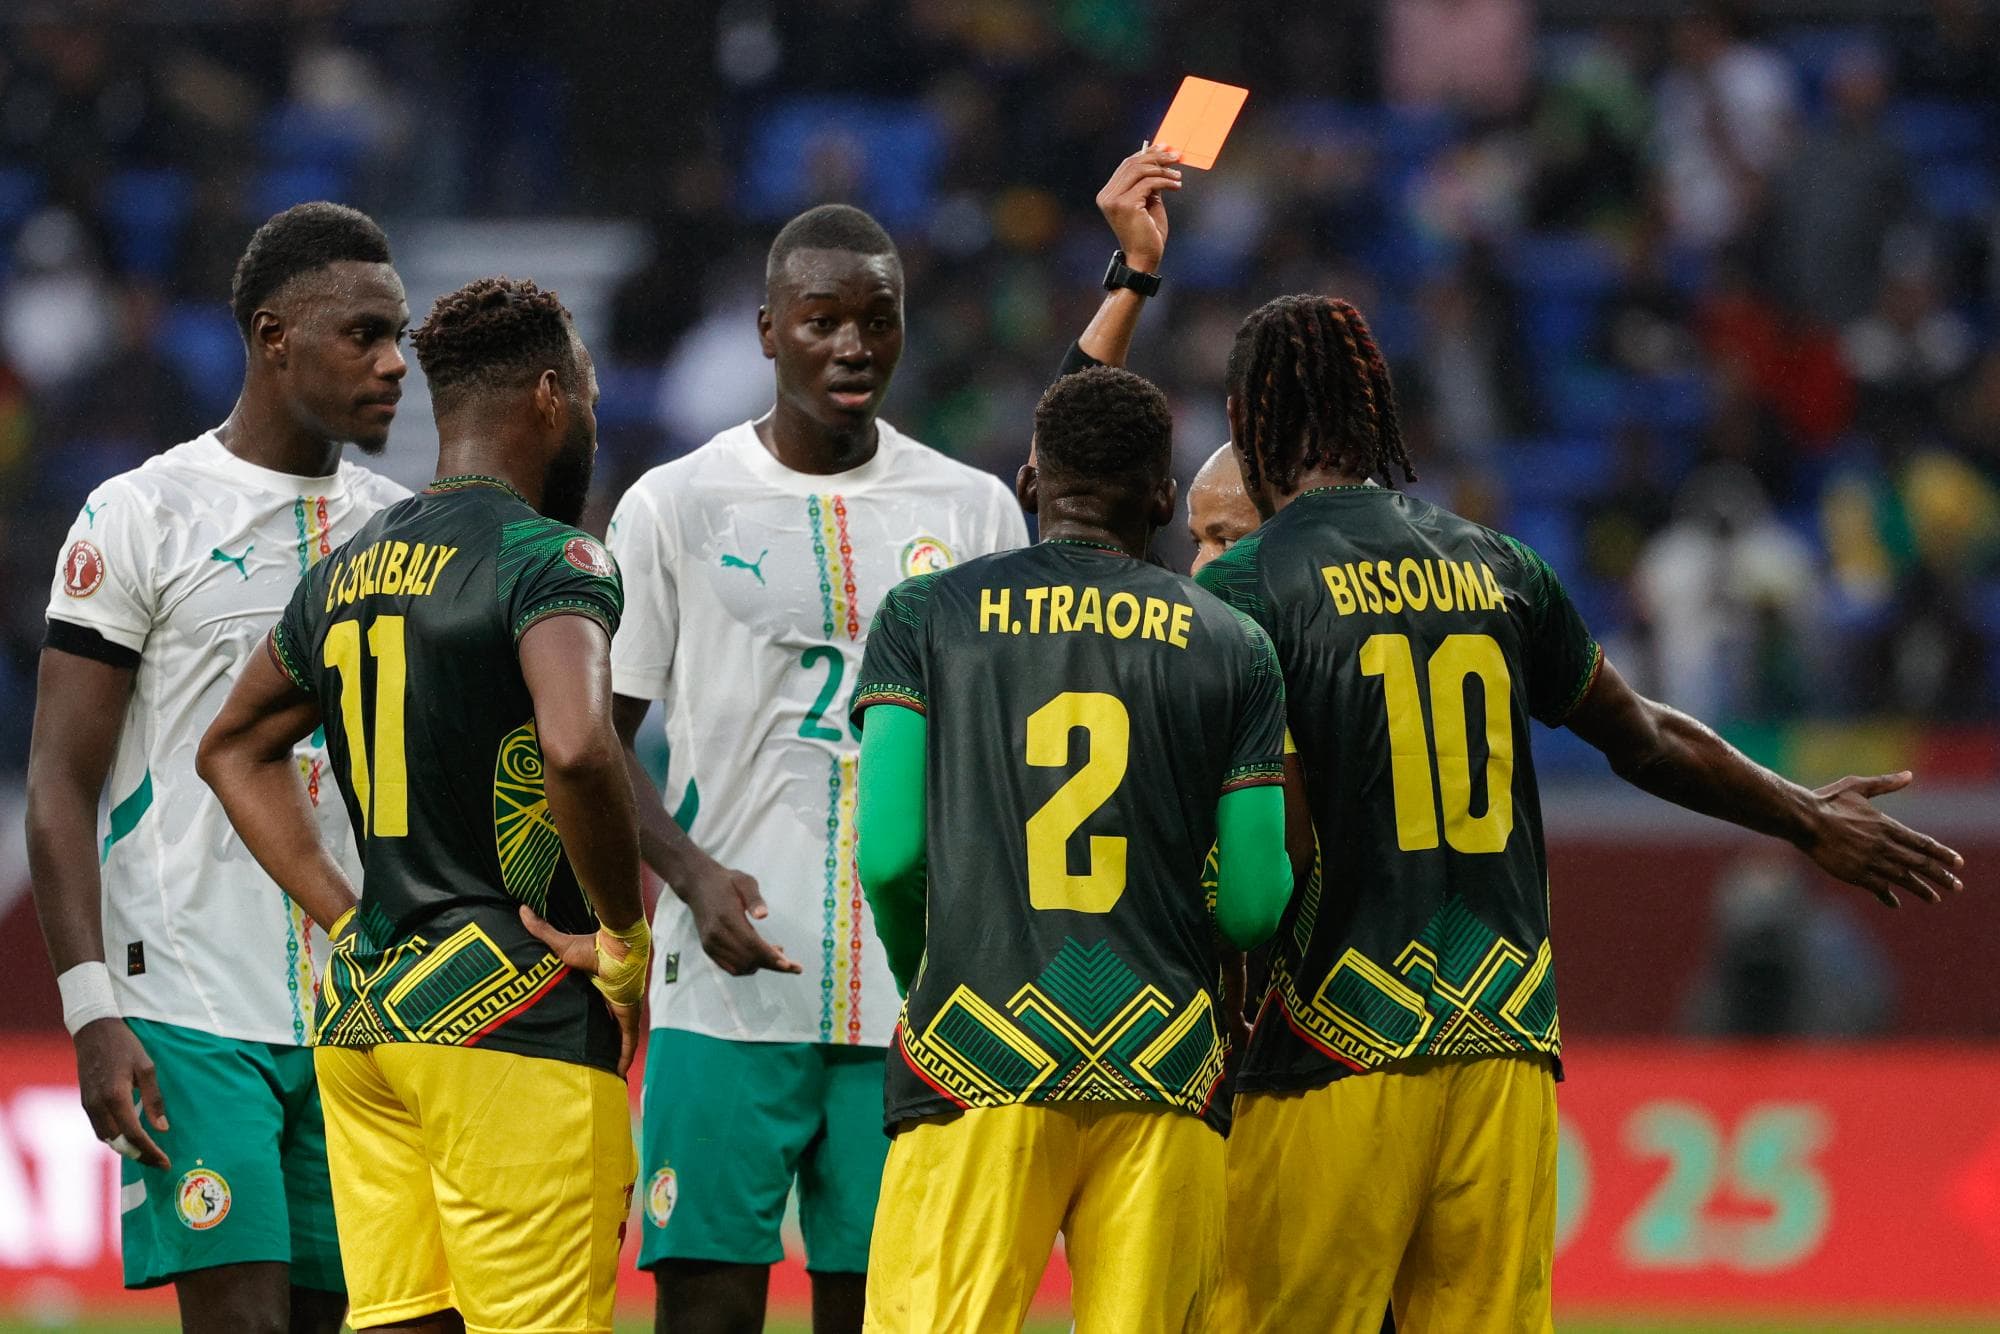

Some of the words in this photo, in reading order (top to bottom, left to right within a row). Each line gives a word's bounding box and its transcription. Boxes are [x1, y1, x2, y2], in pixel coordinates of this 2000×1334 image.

[979, 585, 1193, 649] H.TRAORE
[1321, 557, 1508, 616] BISSOUMA
[323, 614, 409, 840] 11
[798, 645, 864, 744] 2
[1359, 634, 1513, 854] 10
[1026, 691, 1130, 914] 2
